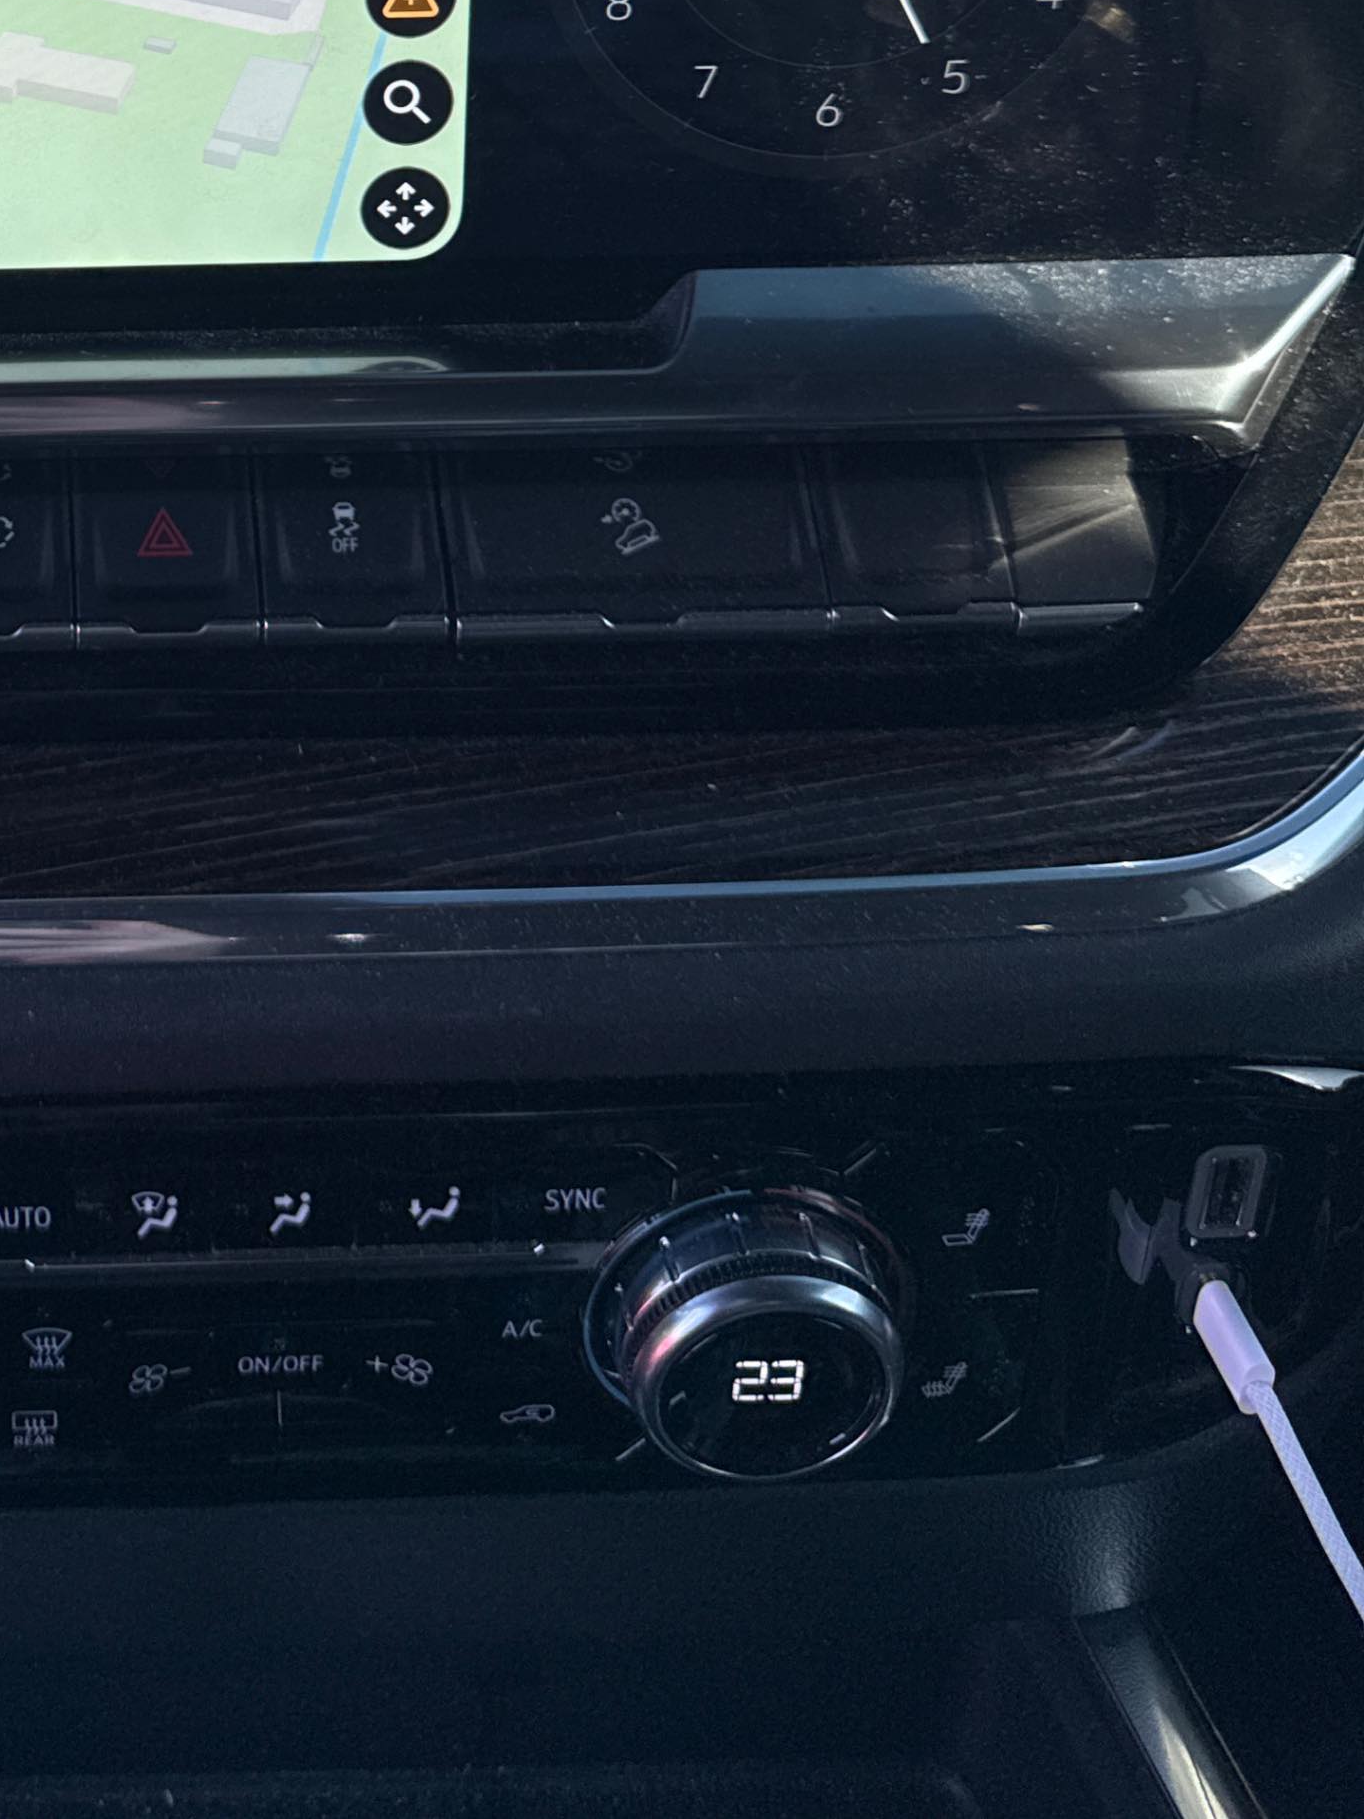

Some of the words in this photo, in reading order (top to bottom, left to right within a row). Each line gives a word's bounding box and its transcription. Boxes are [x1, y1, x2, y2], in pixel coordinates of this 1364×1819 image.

[694, 64, 719, 100] 7
[941, 59, 971, 95] 5
[815, 93, 843, 129] 6
[331, 536, 359, 553] OFF
[543, 1186, 608, 1213] SYNC
[501, 1318, 544, 1339] A/C
[28, 1354, 66, 1369] MAX
[237, 1353, 325, 1375] ON/OFF
[732, 1359, 805, 1402] 23
